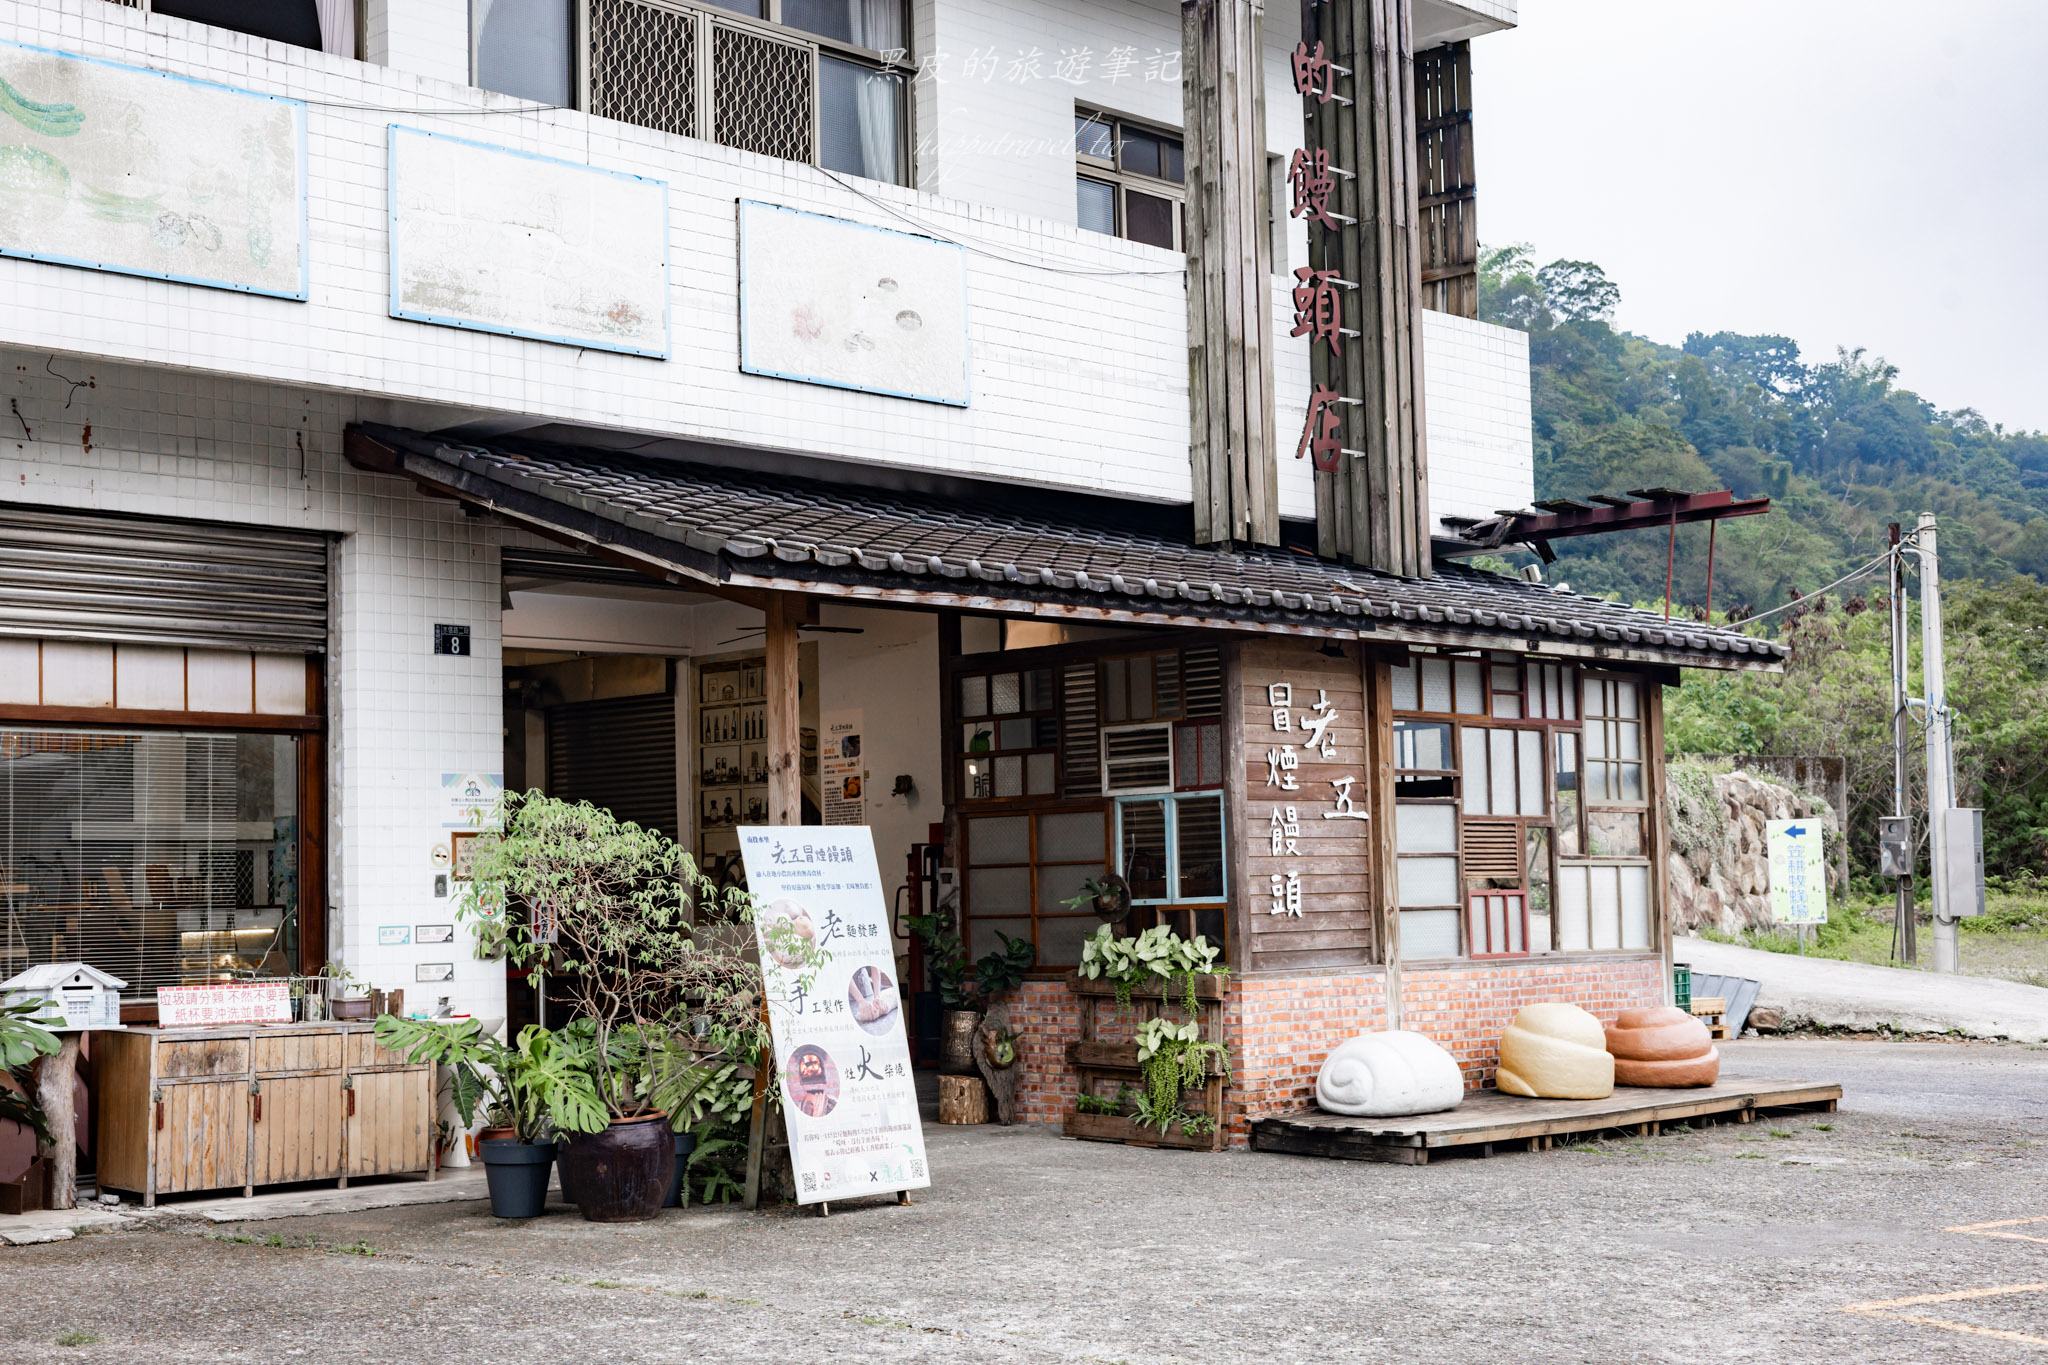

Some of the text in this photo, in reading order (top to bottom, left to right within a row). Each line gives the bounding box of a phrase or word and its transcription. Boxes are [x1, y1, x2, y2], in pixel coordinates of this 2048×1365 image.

[1286, 40, 1343, 474] 的饅頭店
[451, 636, 460, 654] 8
[1300, 689, 1369, 820] 老五
[1267, 682, 1303, 918] 冒煙饅頭
[771, 841, 854, 864] 老五冒煙饅頭
[159, 988, 289, 1006] 垃圾請分類 不然不要丟
[788, 979, 843, 1015] 手工製作
